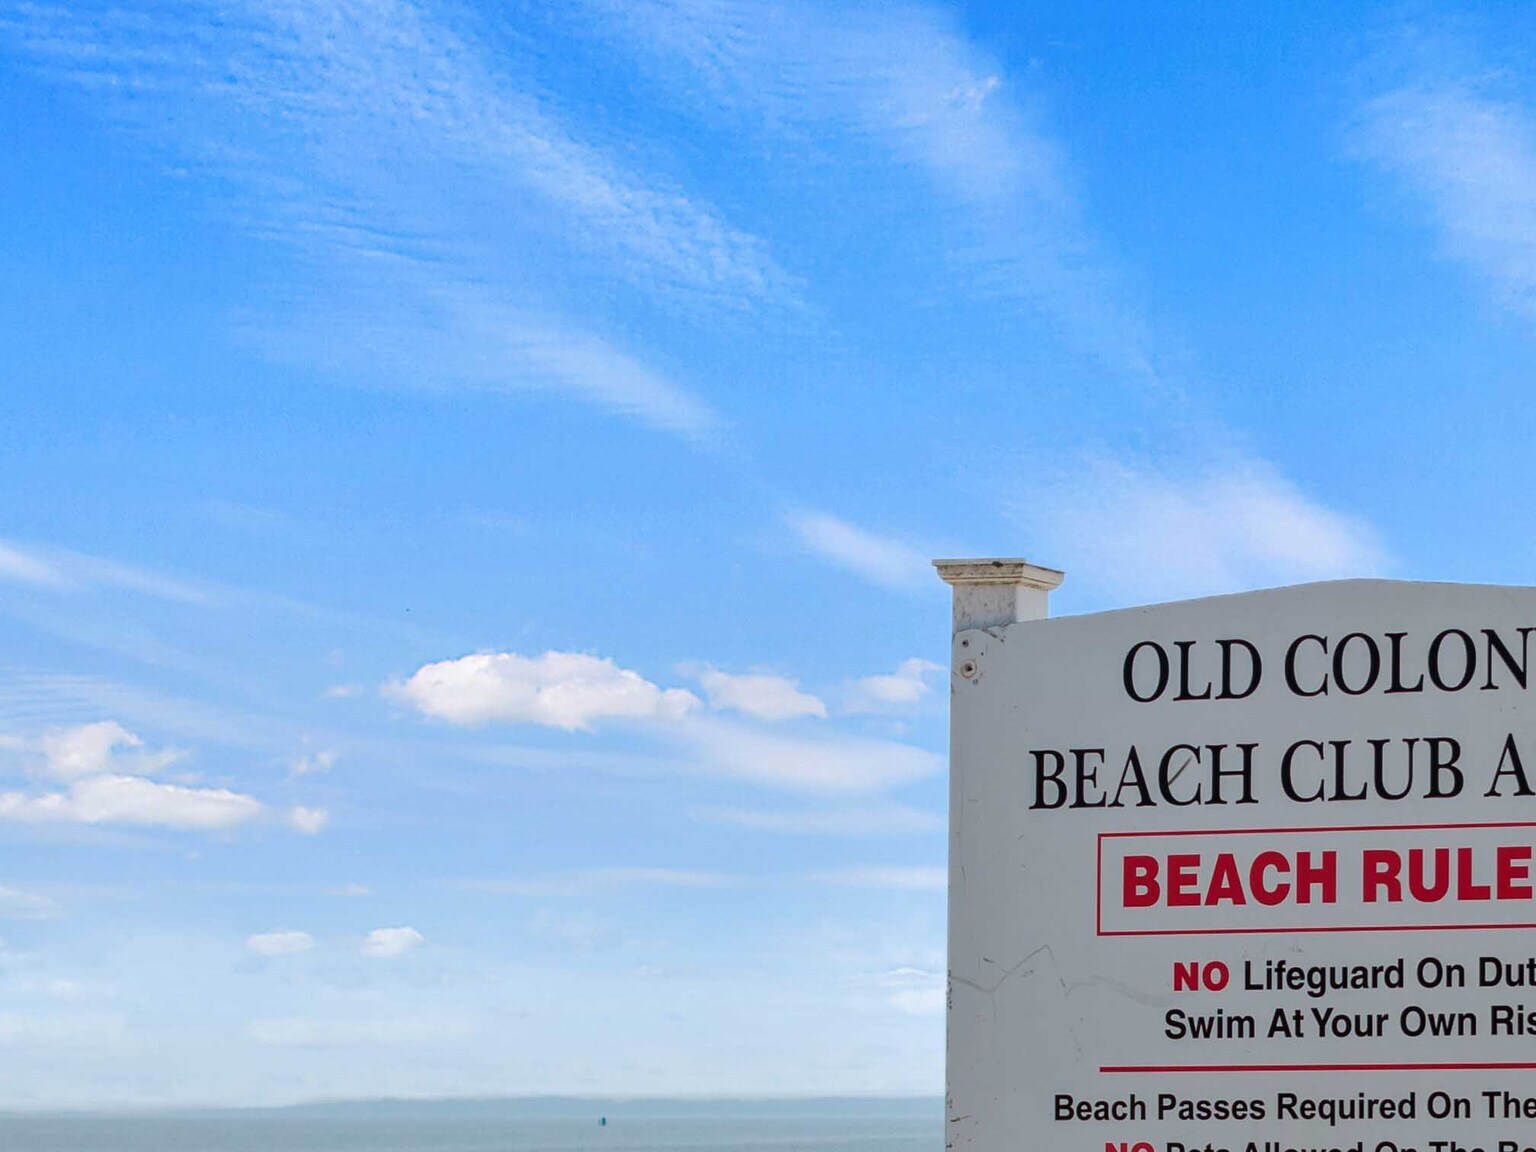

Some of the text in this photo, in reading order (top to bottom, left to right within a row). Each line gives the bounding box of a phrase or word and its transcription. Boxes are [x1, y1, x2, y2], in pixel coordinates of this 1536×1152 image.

[1122, 638, 1263, 703] OLD
[1028, 742, 1260, 810] BEACH
[1280, 737, 1464, 803] CLUB
[1122, 850, 1337, 908] BEACH
[1173, 960, 1230, 992] NO
[1244, 958, 1404, 999] Lifeguard
[1416, 956, 1465, 989] On
[1164, 1008, 1255, 1040] Swim
[1267, 1008, 1305, 1038] At
[1310, 1007, 1389, 1038] Your
[1400, 1005, 1477, 1037] Own
[1054, 1093, 1147, 1121] Beach
[1158, 1093, 1266, 1121] Passes
[1277, 1091, 1416, 1126] Required
[1427, 1091, 1471, 1120] On
